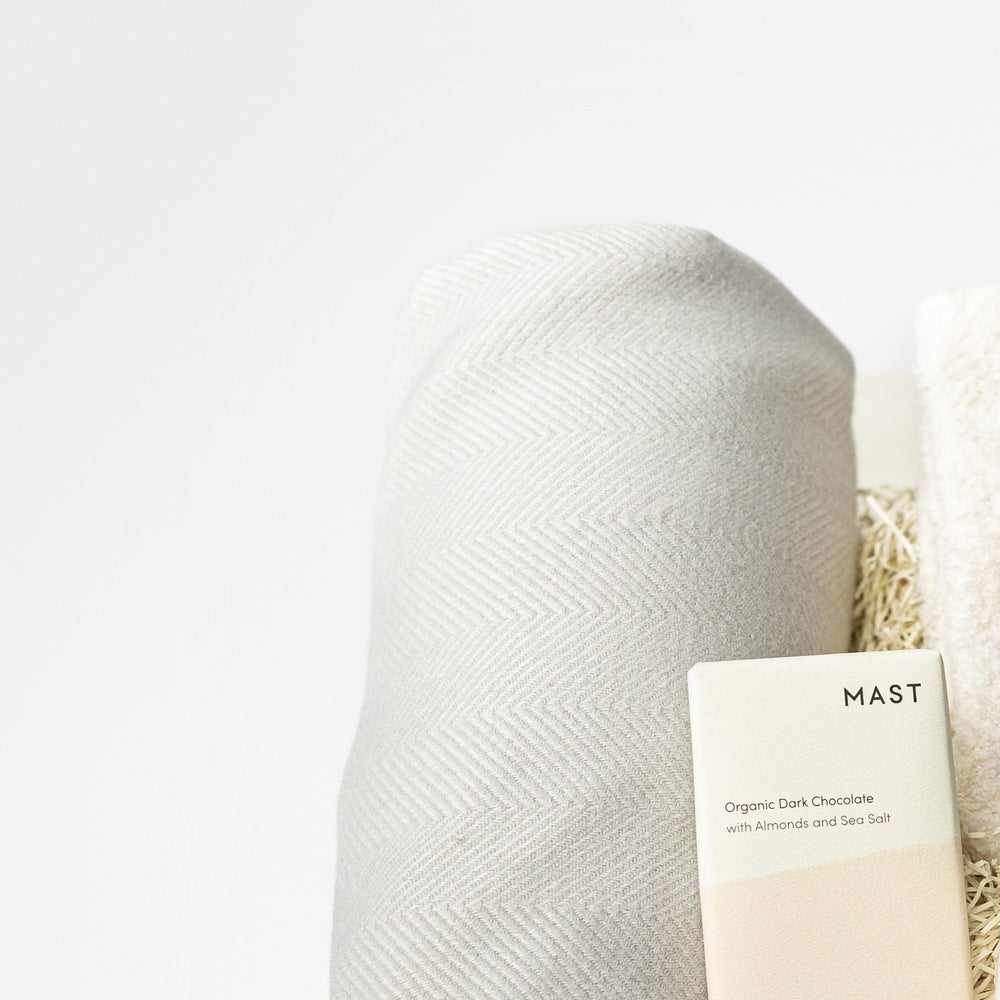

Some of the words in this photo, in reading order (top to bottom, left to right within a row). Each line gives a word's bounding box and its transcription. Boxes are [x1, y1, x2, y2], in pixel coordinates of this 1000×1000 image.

[844, 683, 922, 706] MAST
[725, 800, 775, 815] Organic
[779, 797, 808, 810] Dark
[812, 794, 874, 807] Chocolate
[726, 821, 752, 834] with
[755, 818, 809, 831] Almonds
[813, 816, 836, 828] and
[841, 815, 864, 826] Sea
[868, 813, 891, 824] Salt
